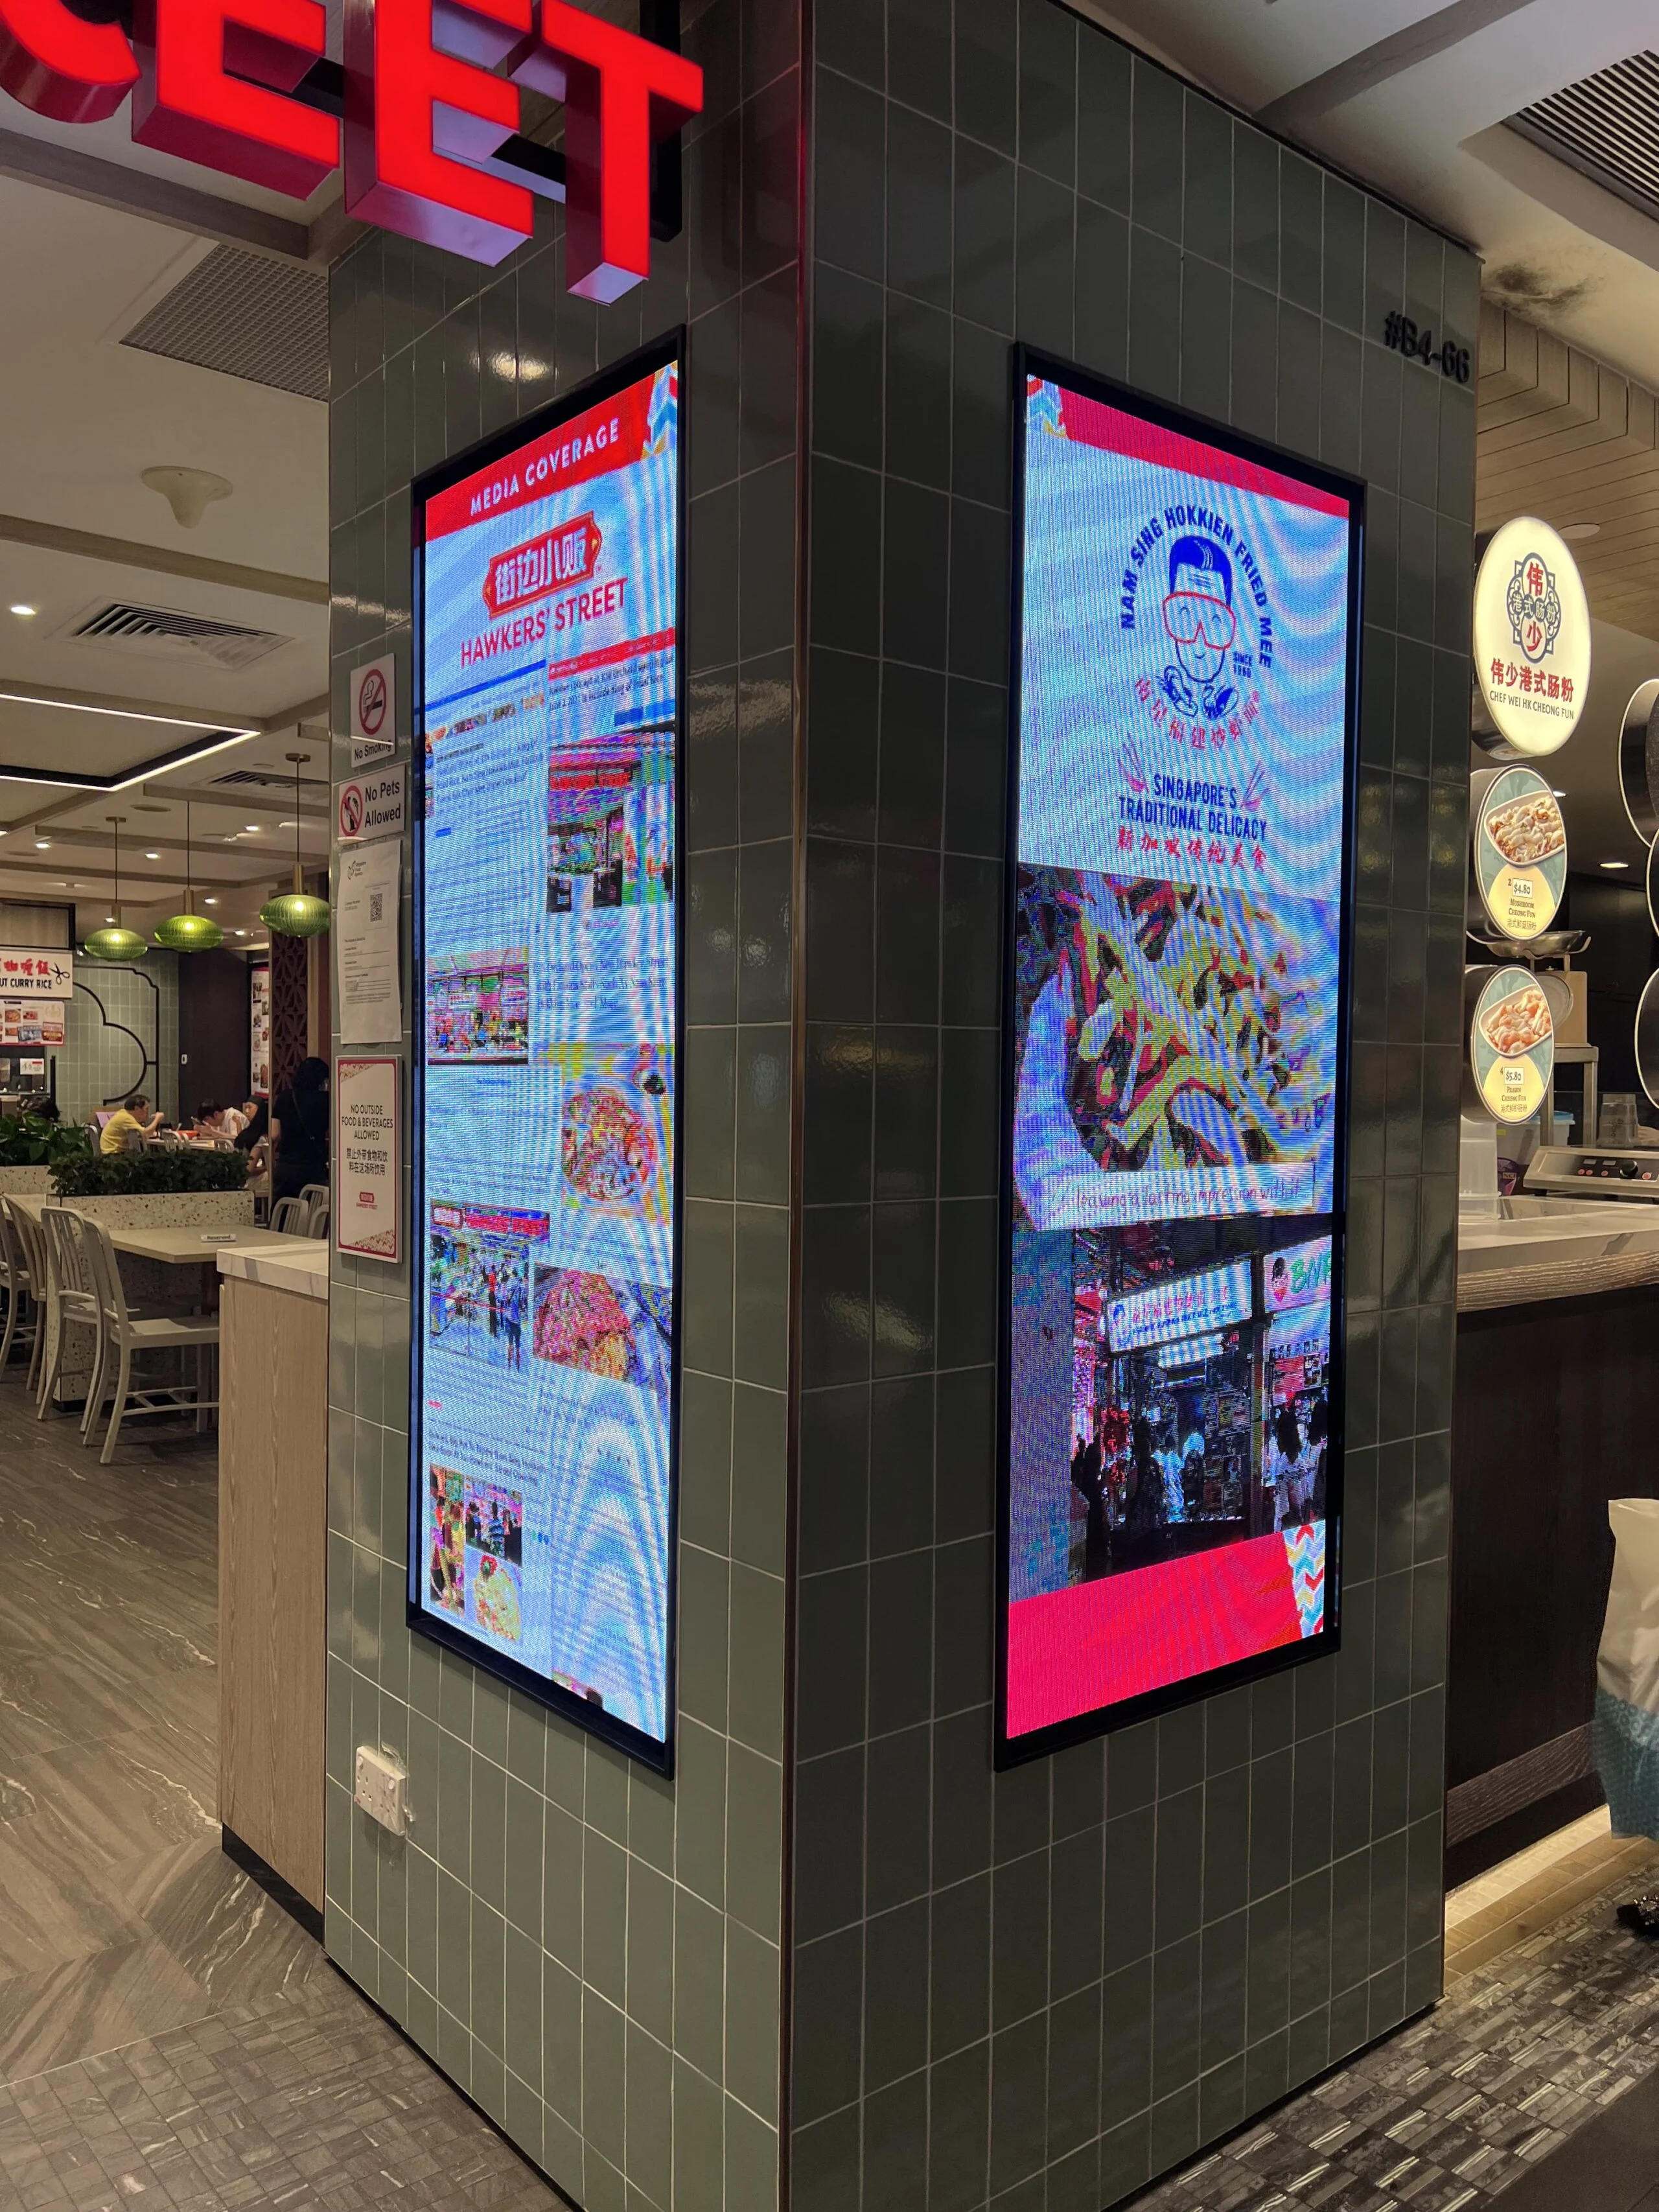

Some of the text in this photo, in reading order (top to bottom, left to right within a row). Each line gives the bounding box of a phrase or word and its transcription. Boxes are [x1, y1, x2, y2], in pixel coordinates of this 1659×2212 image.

[0, 0, 704, 282] EET
[1384, 310, 1470, 384] #B4-66
[470, 417, 619, 516] MEDIA COVERAGE
[1120, 504, 1272, 668] NAM SING HOKKIEN FRIED MEE
[1526, 562, 1544, 597] 伟
[461, 608, 550, 668] HAWKERS'
[555, 577, 628, 632] STREET
[1512, 594, 1557, 623] 港式肠粉
[1526, 621, 1542, 652] 少
[1233, 651, 1252, 667] SINCE
[1491, 657, 1574, 703] 伟少港式肠粉
[1490, 690, 1574, 720] CHEF WEI HK CHEONG FUN
[354, 740, 392, 761] No Smoking
[365, 780, 400, 803] No Pets
[1154, 773, 1237, 809] SINGAPORE'S
[365, 803, 401, 828] Allowed
[1119, 796, 1267, 841] TRADITIONAL DELICACY
[1514, 883, 1531, 894] $4.80
[10, 978, 34, 988] CURRY
[36, 979, 52, 989] RICE
[1500, 1067, 1522, 1082] 4 $5.80
[342, 1116, 393, 1128] FOOD & BEVERAGES
[351, 1104, 383, 1115] NO OUTSIDE
[354, 1130, 380, 1140] ALLOWED
